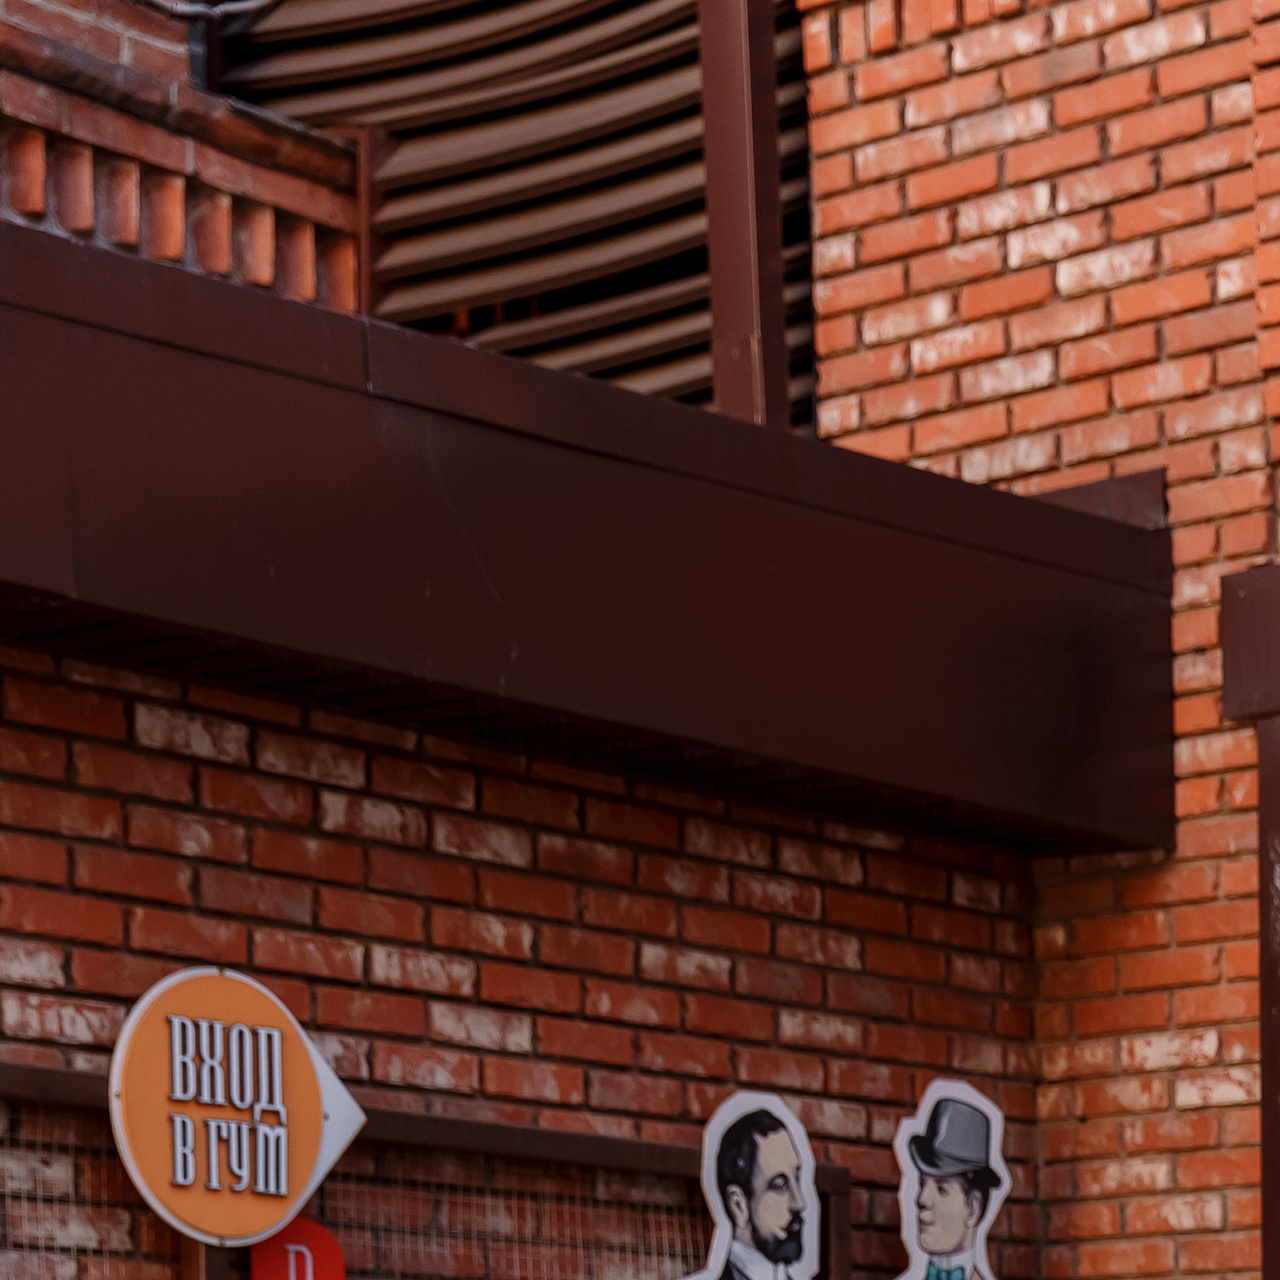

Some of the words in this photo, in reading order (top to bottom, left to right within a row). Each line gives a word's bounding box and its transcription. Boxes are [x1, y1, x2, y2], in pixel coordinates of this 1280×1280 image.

[166, 1014, 287, 1126] ВХОД
[170, 1113, 196, 1187] В
[204, 1118, 288, 1196] ГУМ
